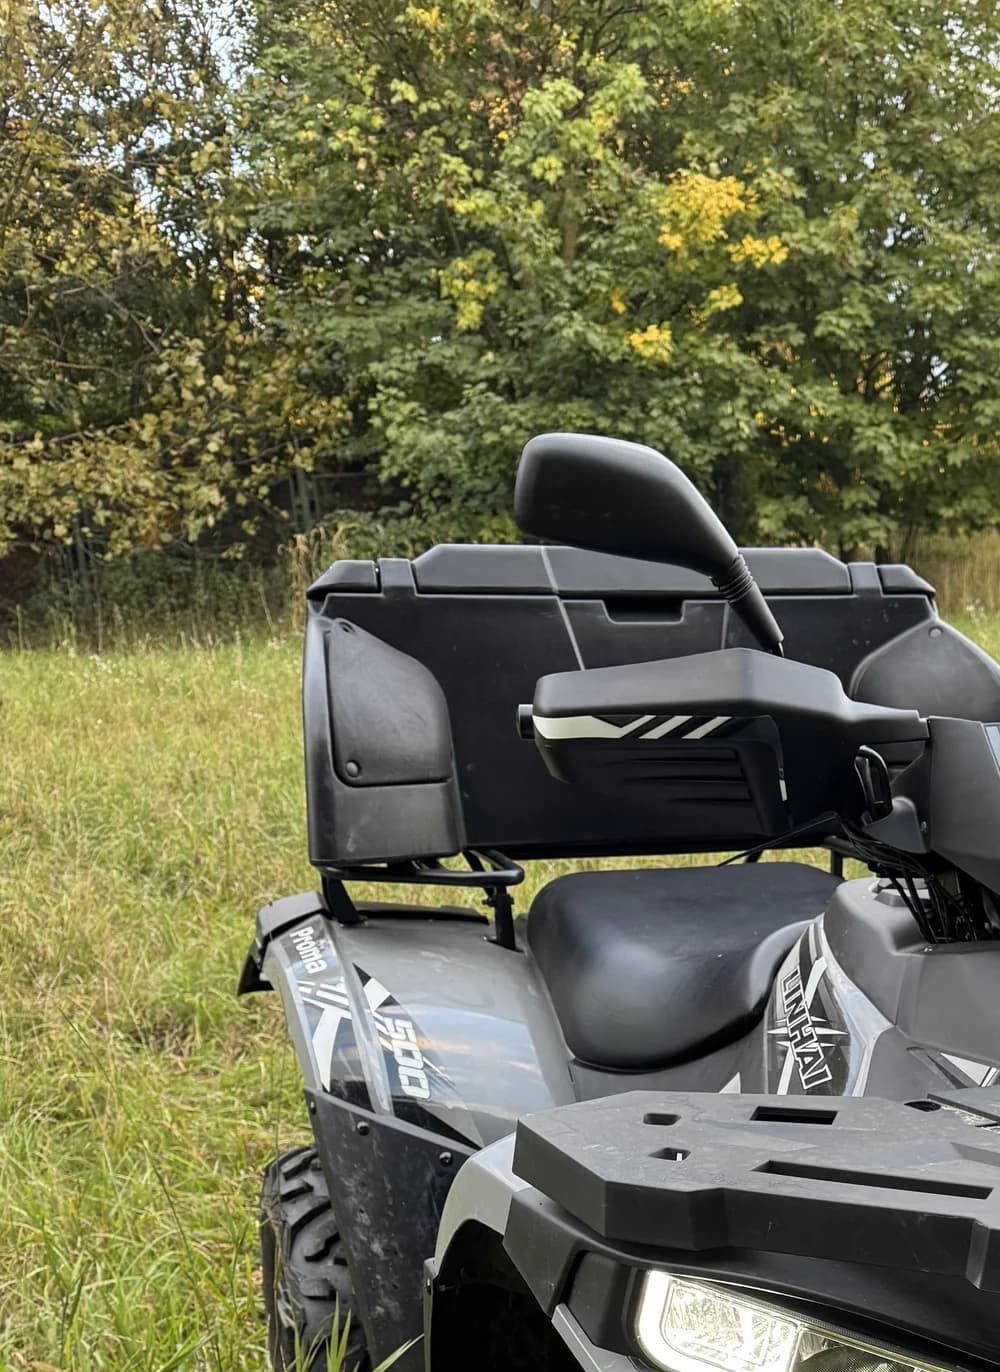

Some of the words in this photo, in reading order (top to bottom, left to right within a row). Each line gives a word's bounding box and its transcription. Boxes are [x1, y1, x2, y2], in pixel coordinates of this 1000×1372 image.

[289, 926, 327, 973] Proma
[390, 1017, 431, 1099] 500
[781, 968, 832, 1090] LINHAI
